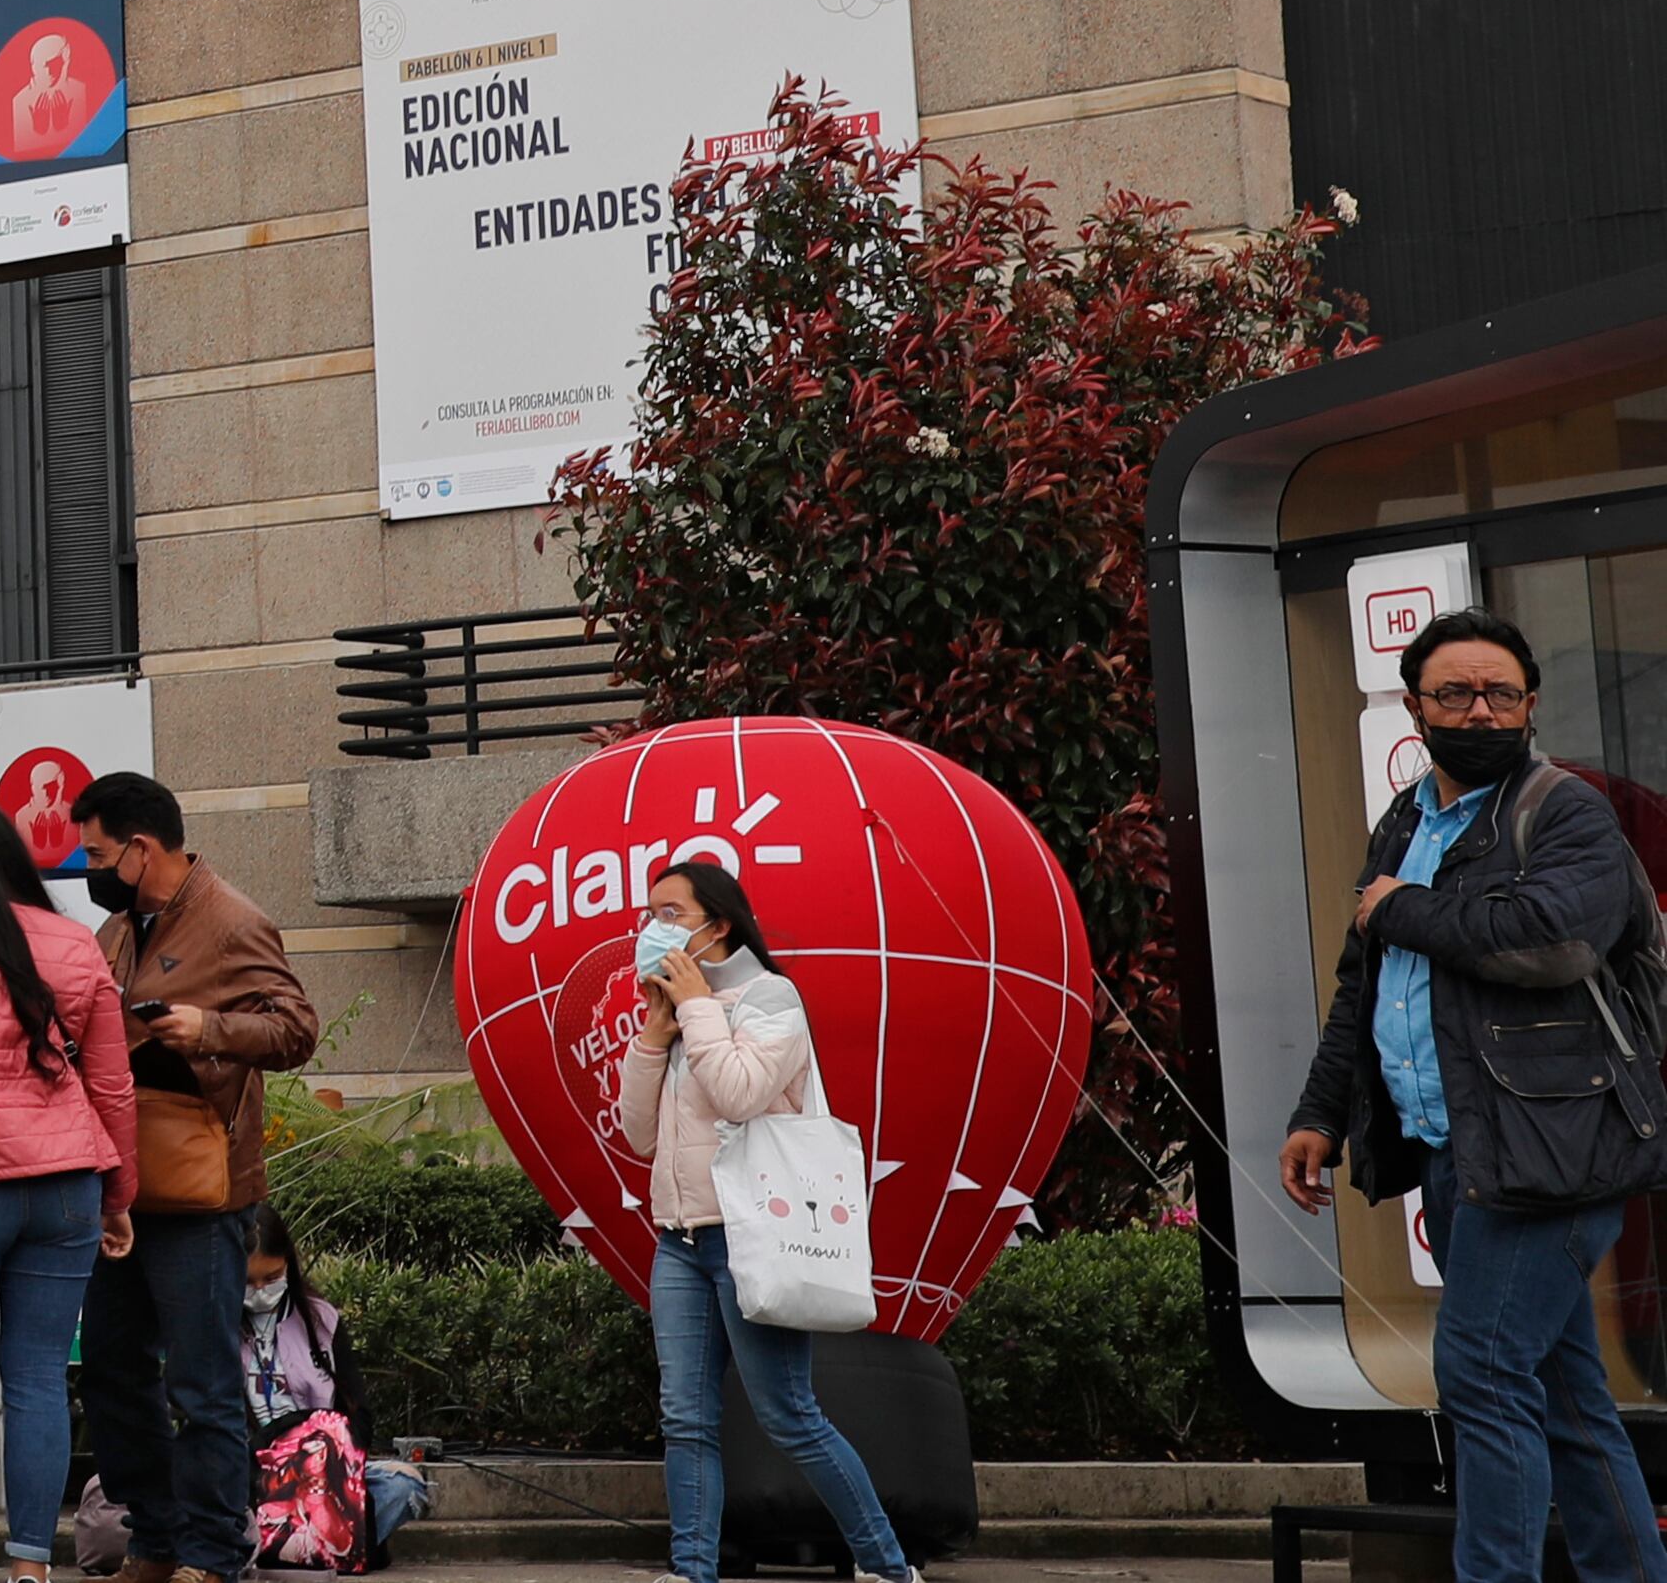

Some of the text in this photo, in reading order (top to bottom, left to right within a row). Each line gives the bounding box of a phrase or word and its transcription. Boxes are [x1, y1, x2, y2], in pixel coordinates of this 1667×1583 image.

[407, 38, 546, 79] PABELLÓN 6 NIVEL 1
[402, 72, 530, 136] EDICIÓN
[859, 117, 869, 135] 2
[404, 116, 570, 179] NACIONAL
[474, 182, 662, 250] ENTIDADES
[437, 384, 615, 421] CONSULTA LA PROGRAMACIÓN EN:
[475, 410, 581, 438] FERIADELLIBRO.COM
[1387, 608, 1417, 635] HD
[570, 1001, 649, 1069] VELOC
[788, 1243, 841, 1260] meow
